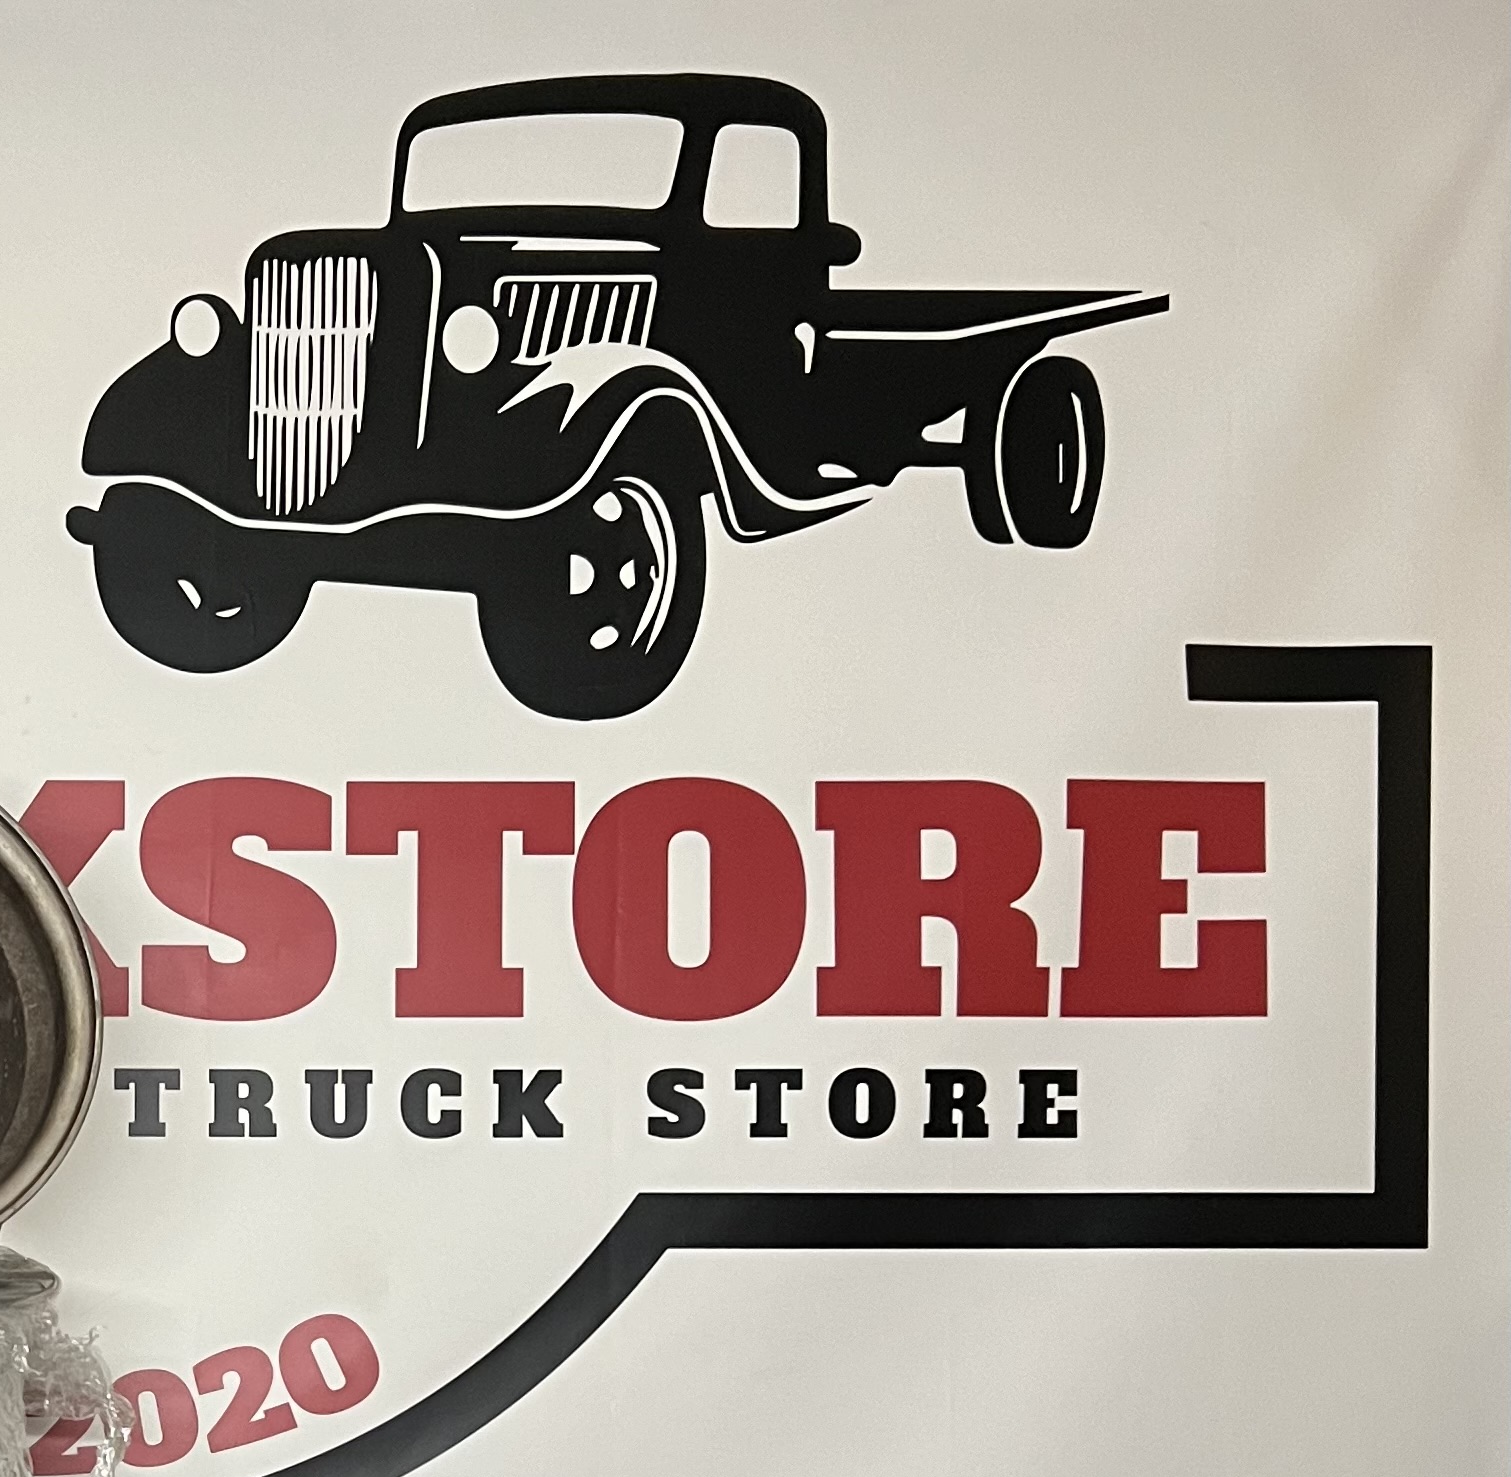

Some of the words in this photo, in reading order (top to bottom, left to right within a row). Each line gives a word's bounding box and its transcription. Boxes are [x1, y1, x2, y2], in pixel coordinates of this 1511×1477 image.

[113, 1068, 564, 1139] TRUCK
[646, 1067, 1078, 1140] STORE
[26, 1314, 380, 1476] 2020
